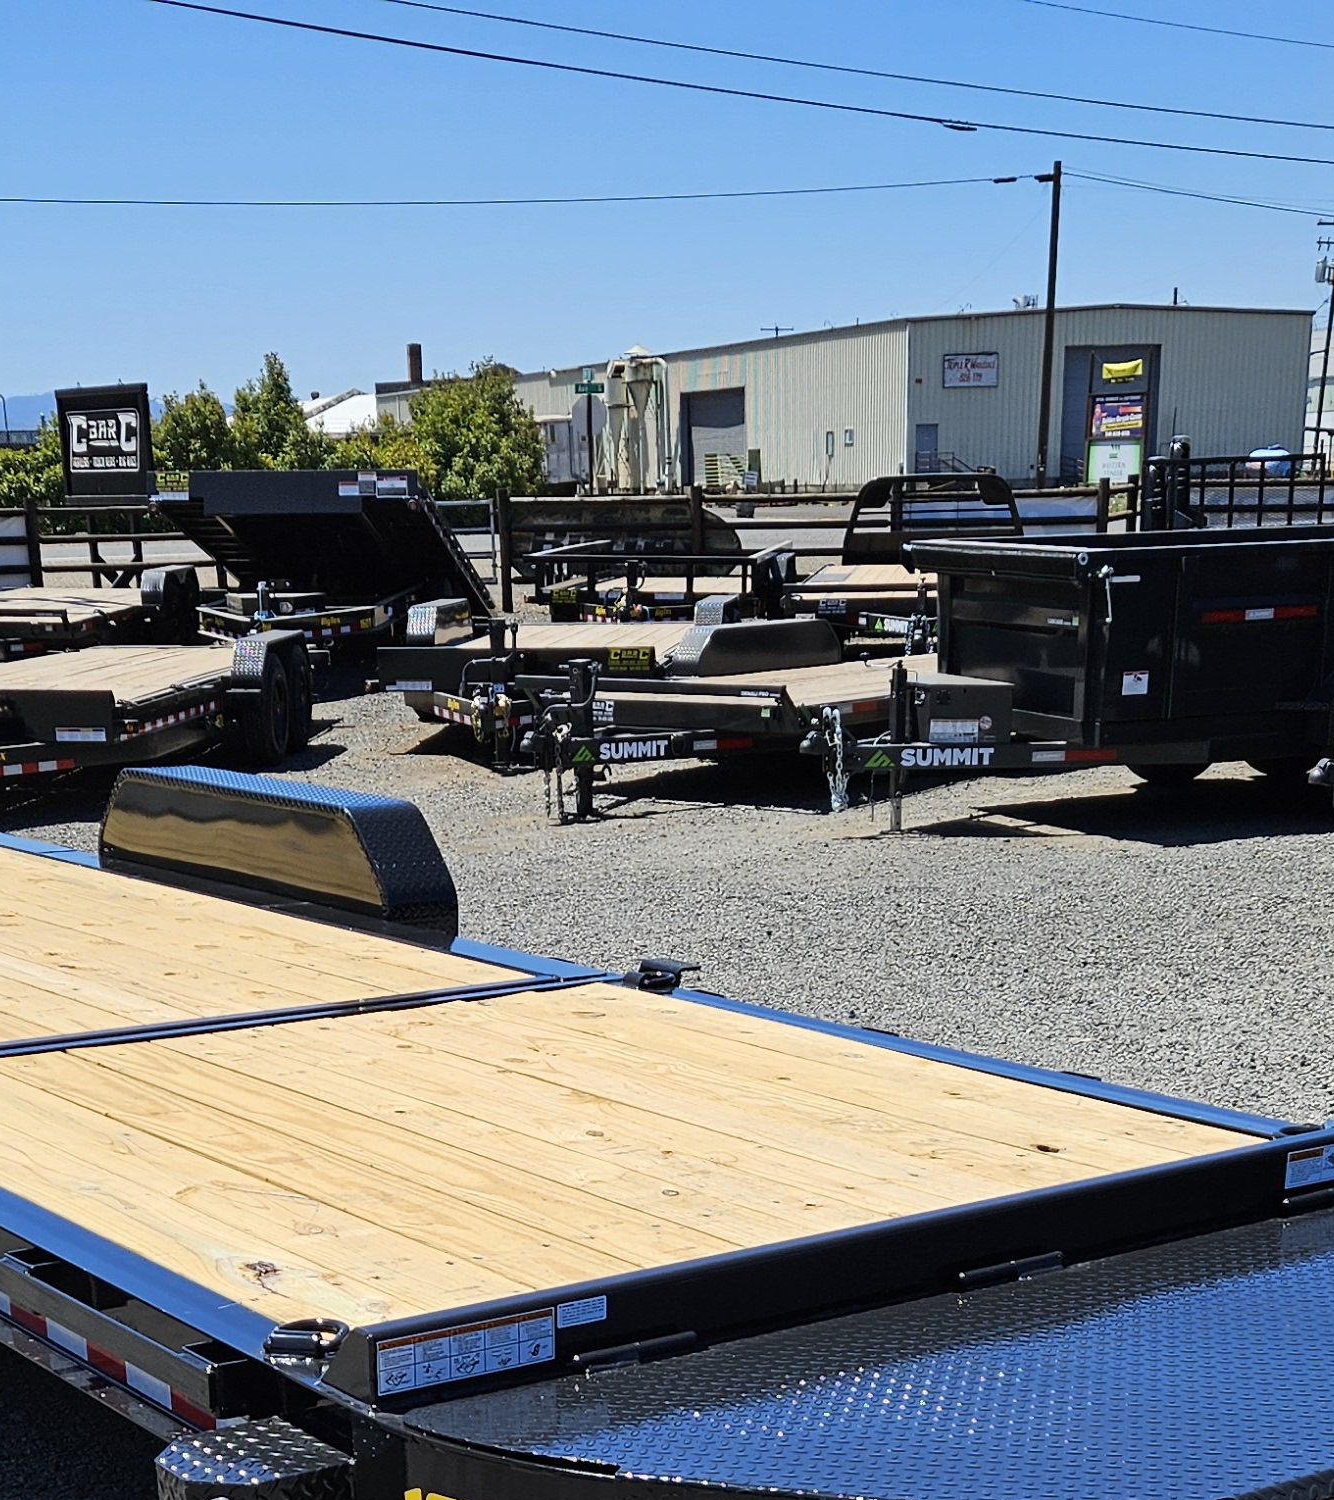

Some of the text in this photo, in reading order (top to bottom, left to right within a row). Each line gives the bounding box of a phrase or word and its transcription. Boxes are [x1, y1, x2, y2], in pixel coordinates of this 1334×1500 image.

[67, 412, 137, 453] C BAR C
[599, 739, 668, 760] SUMMIT
[900, 748, 994, 767] SUMMIT
